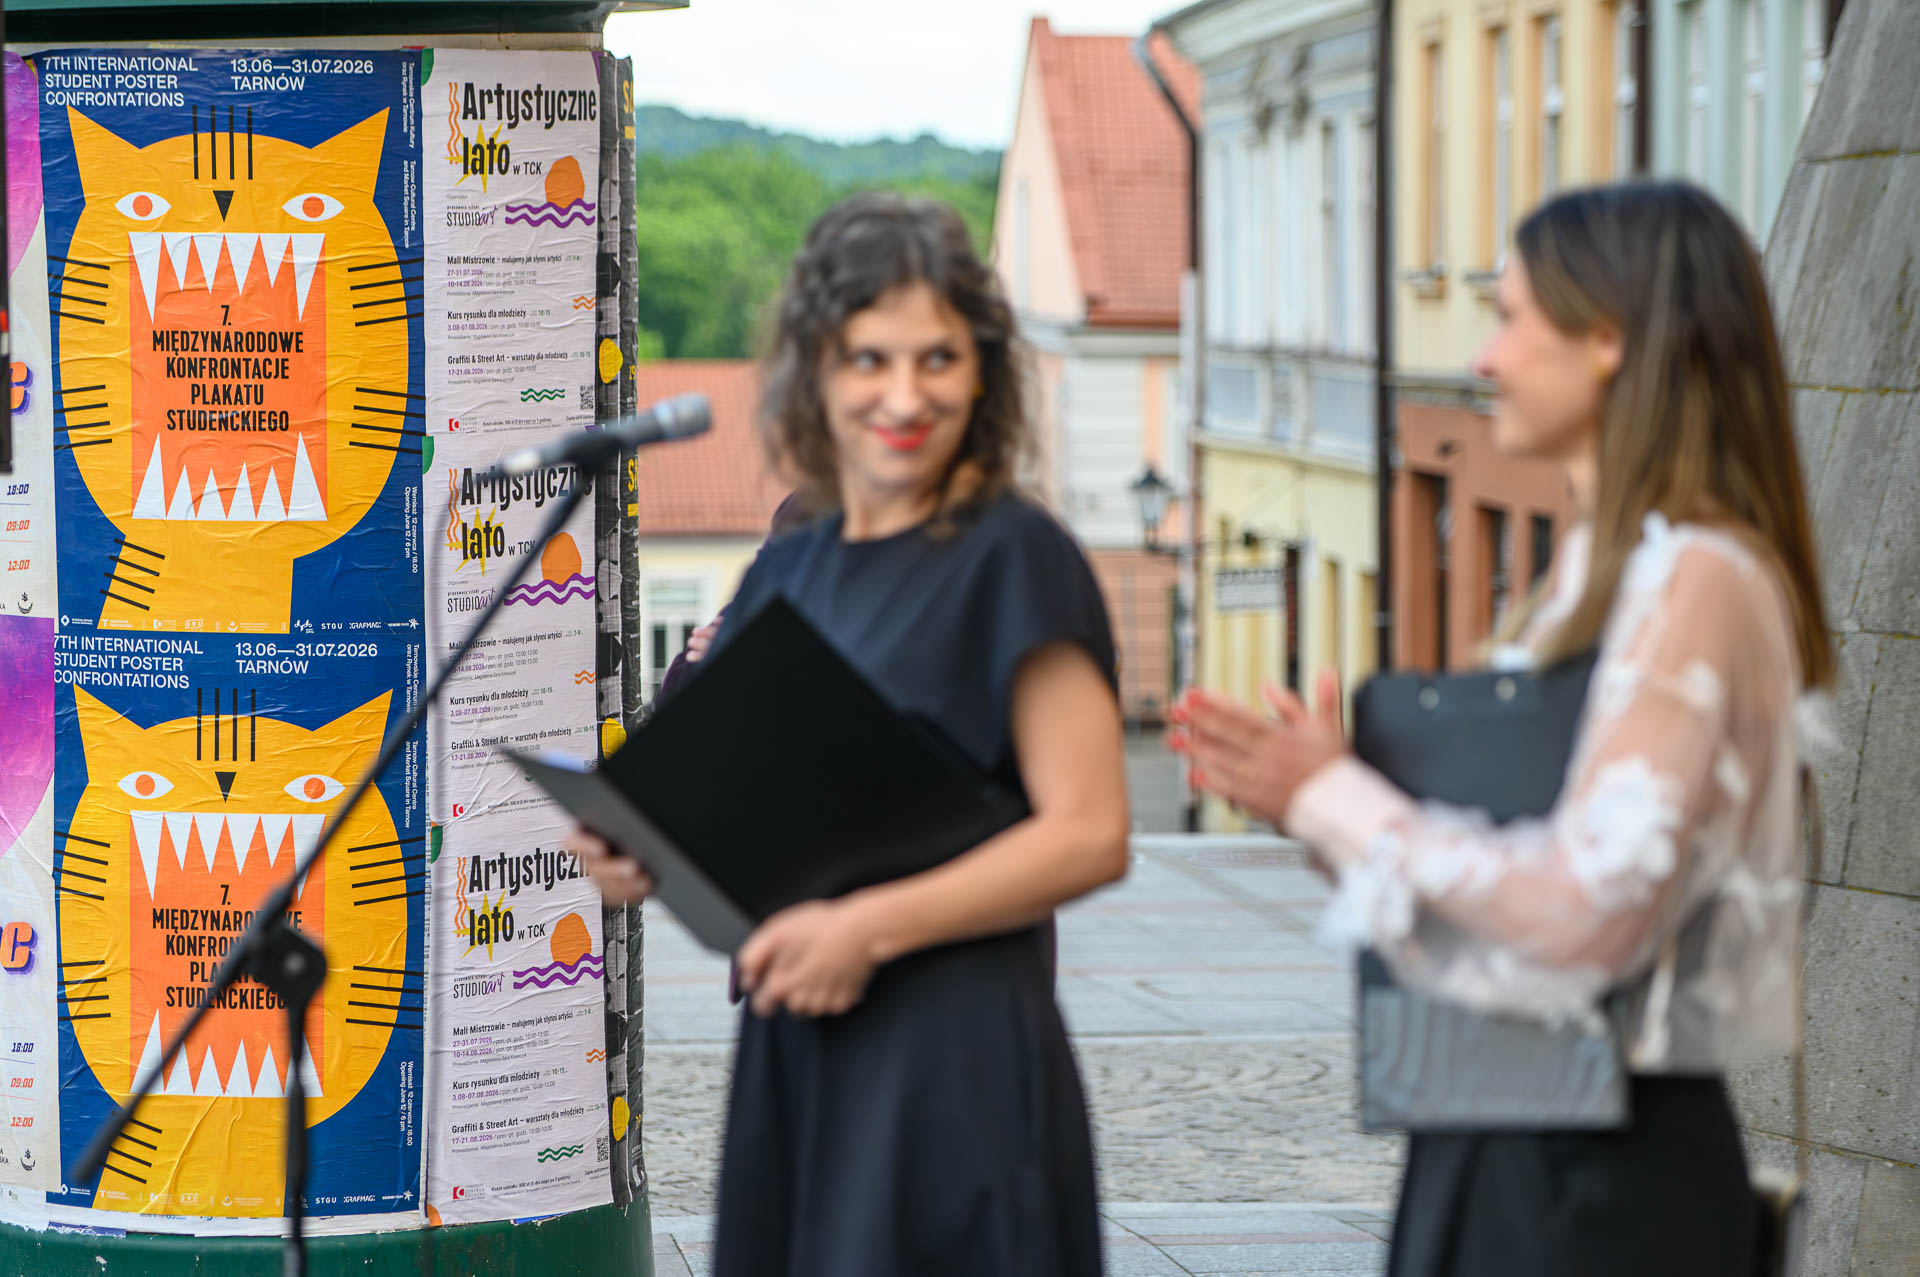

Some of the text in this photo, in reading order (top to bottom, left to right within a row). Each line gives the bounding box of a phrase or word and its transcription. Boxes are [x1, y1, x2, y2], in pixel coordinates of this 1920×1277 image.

[43, 57, 198, 72] 7TH INTERNATIONAL
[45, 74, 178, 89] STUDENT POSTER
[231, 75, 305, 91] TARNÓW
[45, 92, 185, 107] CONFRONTATIONS
[462, 82, 597, 129] Artystyczne
[408, 126, 416, 148] Kultury
[463, 137, 542, 175] lato w TCK
[402, 196, 410, 218] Square
[463, 255, 496, 264] Mistrzowie
[219, 304, 232, 326] 7.
[447, 311, 462, 320] Kurs
[463, 310, 487, 321] rysunku
[488, 310, 497, 318] dla
[152, 330, 304, 357] MIĘDZYNARODOWE
[166, 357, 289, 379] KONFRONTACJE
[447, 355, 471, 365] Graffiti
[477, 354, 496, 363] Street
[496, 354, 505, 362] Art
[190, 384, 264, 406] PLAKATU
[167, 410, 290, 432] STUDENCKIEGO
[7, 483, 30, 495] 18:00
[6, 520, 30, 531] 09:00
[462, 521, 536, 560] lato w TCK
[7, 559, 30, 571] 12:00
[54, 635, 204, 655] 7TH INTERNATIONAL
[502, 637, 525, 646] malujemy
[547, 631, 562, 641] artyści
[54, 652, 184, 672] STUDENT POSTER
[236, 658, 309, 674] TARNÓW
[54, 669, 190, 689] CONFRONTATIONS
[450, 697, 465, 706] Kurs
[466, 694, 489, 706] rysunku
[491, 692, 499, 701] dla
[501, 688, 528, 700] młodzieży
[451, 739, 474, 750] Graffiti
[481, 737, 499, 747] Street
[500, 735, 509, 743] Art
[220, 884, 232, 906] 7.
[470, 906, 546, 946] lato w TCK
[453, 1027, 468, 1036] Mali
[470, 1022, 505, 1034] Mistrzowie
[512, 1018, 535, 1029] malujemy
[558, 1010, 573, 1021] artyści
[12, 1042, 34, 1053] 18:00
[10, 1077, 34, 1088] 09:00
[453, 1080, 469, 1090] Kurs
[471, 1077, 497, 1089] rysunku
[499, 1074, 509, 1083] dla
[510, 1070, 540, 1082] młodzieży
[10, 1116, 33, 1128] 12:00
[452, 1107, 584, 1134] Graffiti & Street Art warsztaty dla młodzieży
